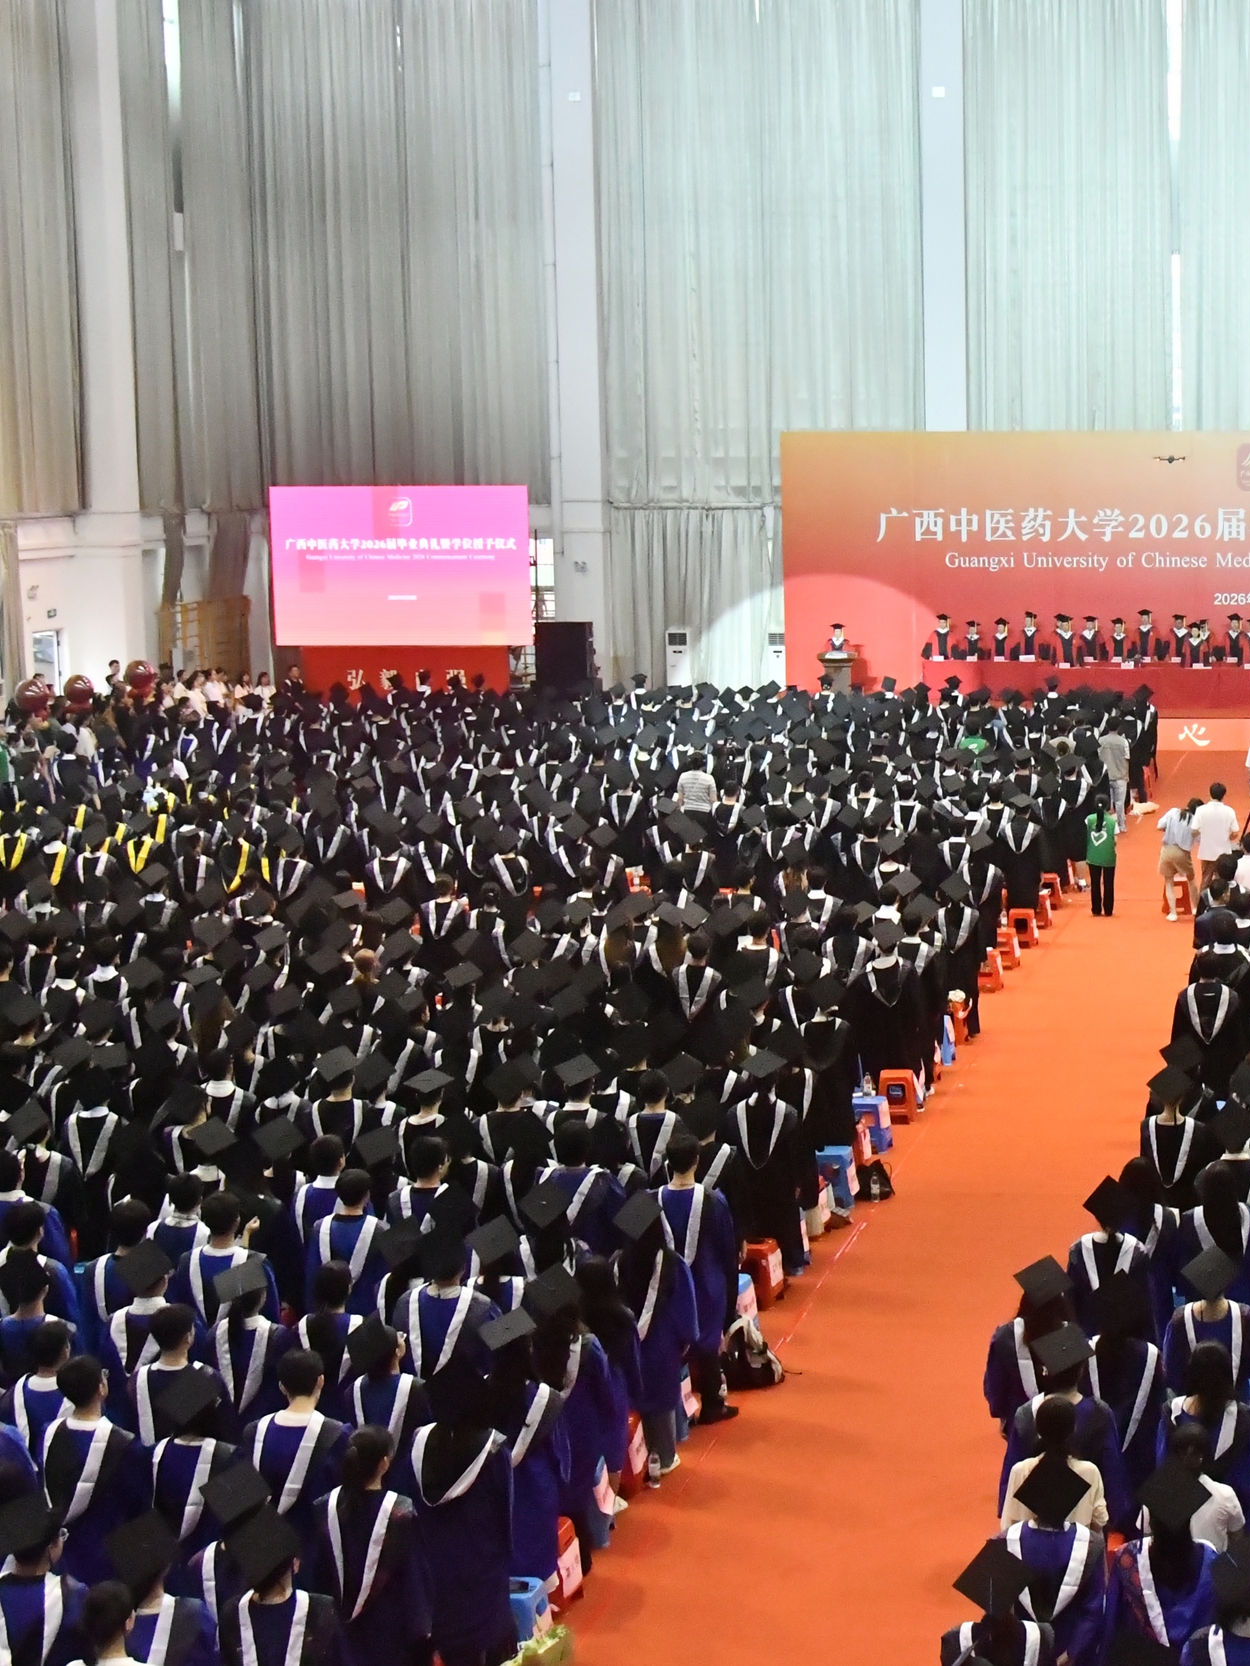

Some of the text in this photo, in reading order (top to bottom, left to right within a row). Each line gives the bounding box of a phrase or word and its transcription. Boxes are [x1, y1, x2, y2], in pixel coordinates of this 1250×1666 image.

[945, 552, 1014, 572] Guangxi
[1023, 552, 1108, 572] University
[1116, 551, 1136, 568] of
[1141, 552, 1207, 568] Chinese
